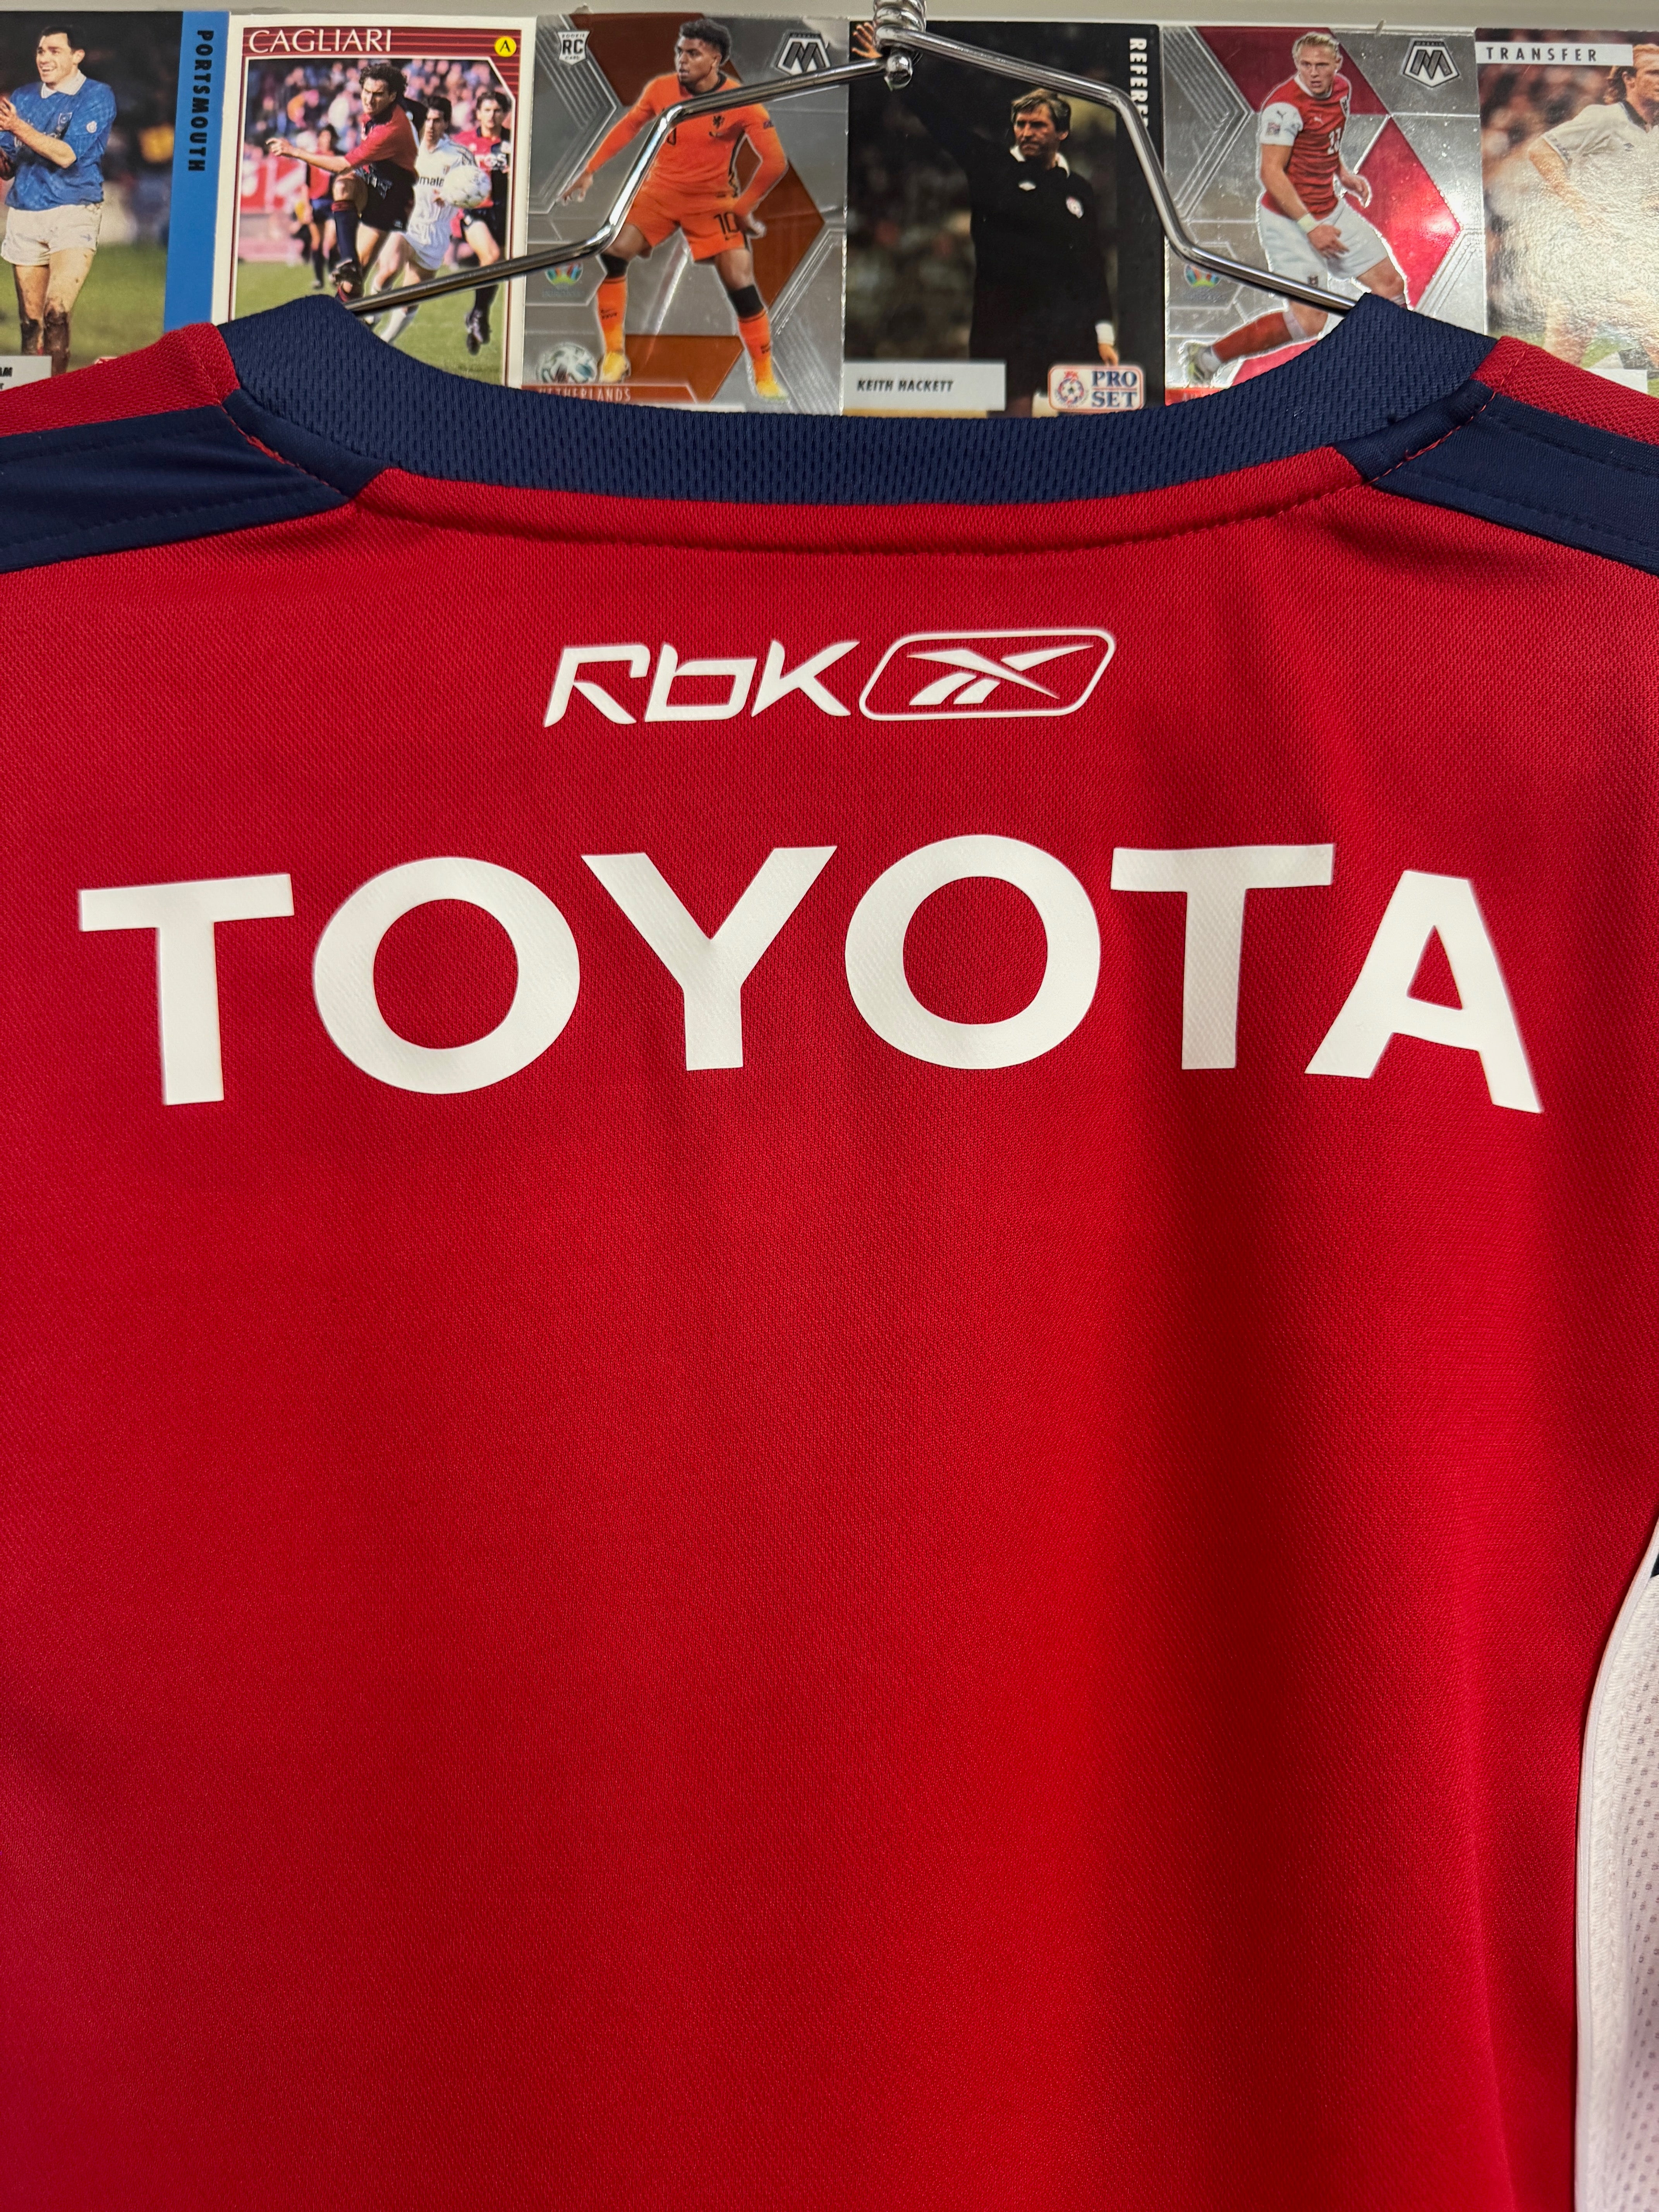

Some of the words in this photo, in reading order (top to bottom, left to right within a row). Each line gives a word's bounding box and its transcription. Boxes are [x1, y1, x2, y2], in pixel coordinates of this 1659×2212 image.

[249, 29, 391, 53] CAGLIARI
[499, 40, 511, 52] A
[563, 39, 583, 55] RC
[1486, 47, 1597, 62] TRANSFER
[1130, 38, 1148, 127] REFERE
[188, 30, 214, 171] PORTSMOUTH
[857, 380, 893, 392] KEITH
[898, 380, 953, 392] HACKETT
[1092, 371, 1137, 387] PRO
[1092, 391, 1137, 408] SET
[77, 833, 1544, 1115] TOYOTA
